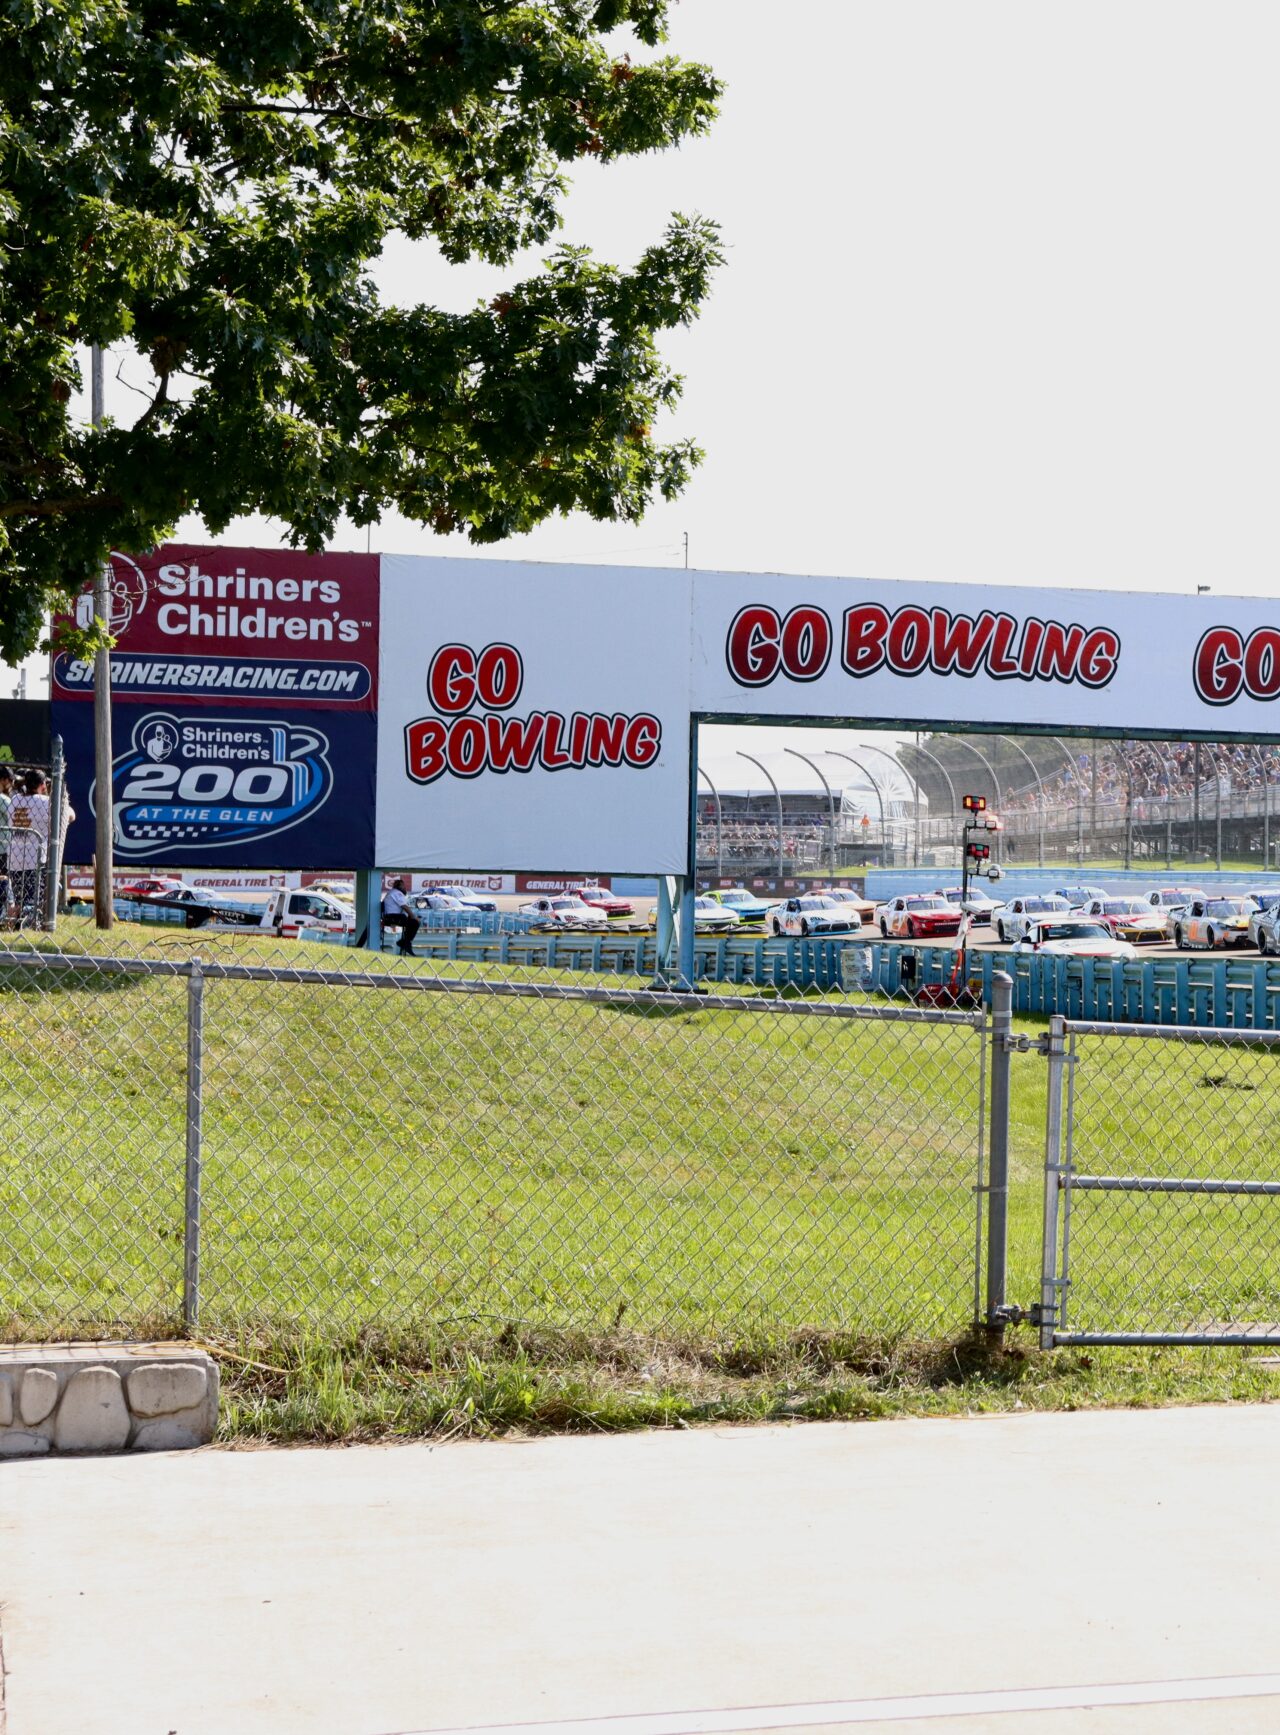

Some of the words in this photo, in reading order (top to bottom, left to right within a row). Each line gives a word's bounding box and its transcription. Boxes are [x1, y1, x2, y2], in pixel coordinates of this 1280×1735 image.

[158, 564, 341, 603] Shriners
[725, 604, 832, 688] GO
[841, 602, 1120, 689] BOWLING
[426, 642, 523, 715] GO
[182, 727, 262, 743] Shriners
[182, 744, 270, 760] Children's
[404, 710, 662, 785] BOWLING
[122, 764, 288, 803] 200
[136, 808, 163, 819] AT
[172, 808, 210, 820] THE
[219, 809, 274, 821] GLEN
[193, 877, 243, 888] GENERAL
[243, 877, 268, 888] TIRE
[421, 879, 465, 888] GENERAL
[464, 879, 487, 889] TIRE
[526, 880, 567, 890] GENERAL
[566, 881, 585, 890] TIRE
